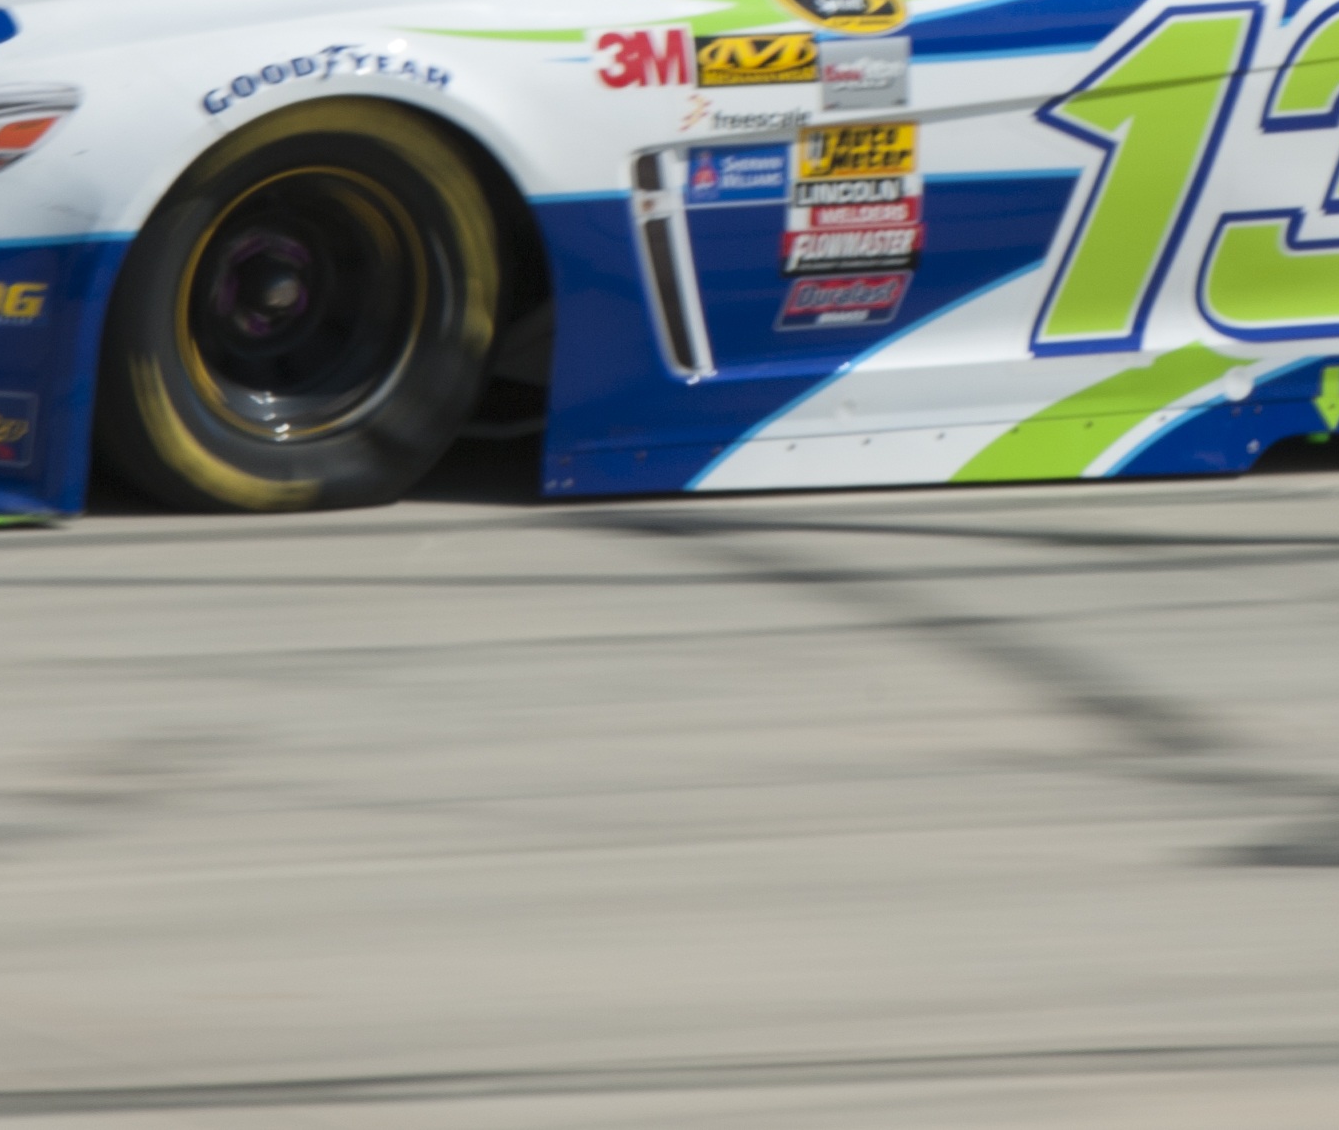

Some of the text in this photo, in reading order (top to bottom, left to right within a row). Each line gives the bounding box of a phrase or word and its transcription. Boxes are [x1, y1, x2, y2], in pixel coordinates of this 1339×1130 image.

[202, 43, 452, 116] GOODYEAR
[596, 28, 692, 89] 3M
[713, 108, 811, 129] freescale
[796, 178, 902, 205] LINCOLN
[785, 229, 917, 272] FLOWMASTER
